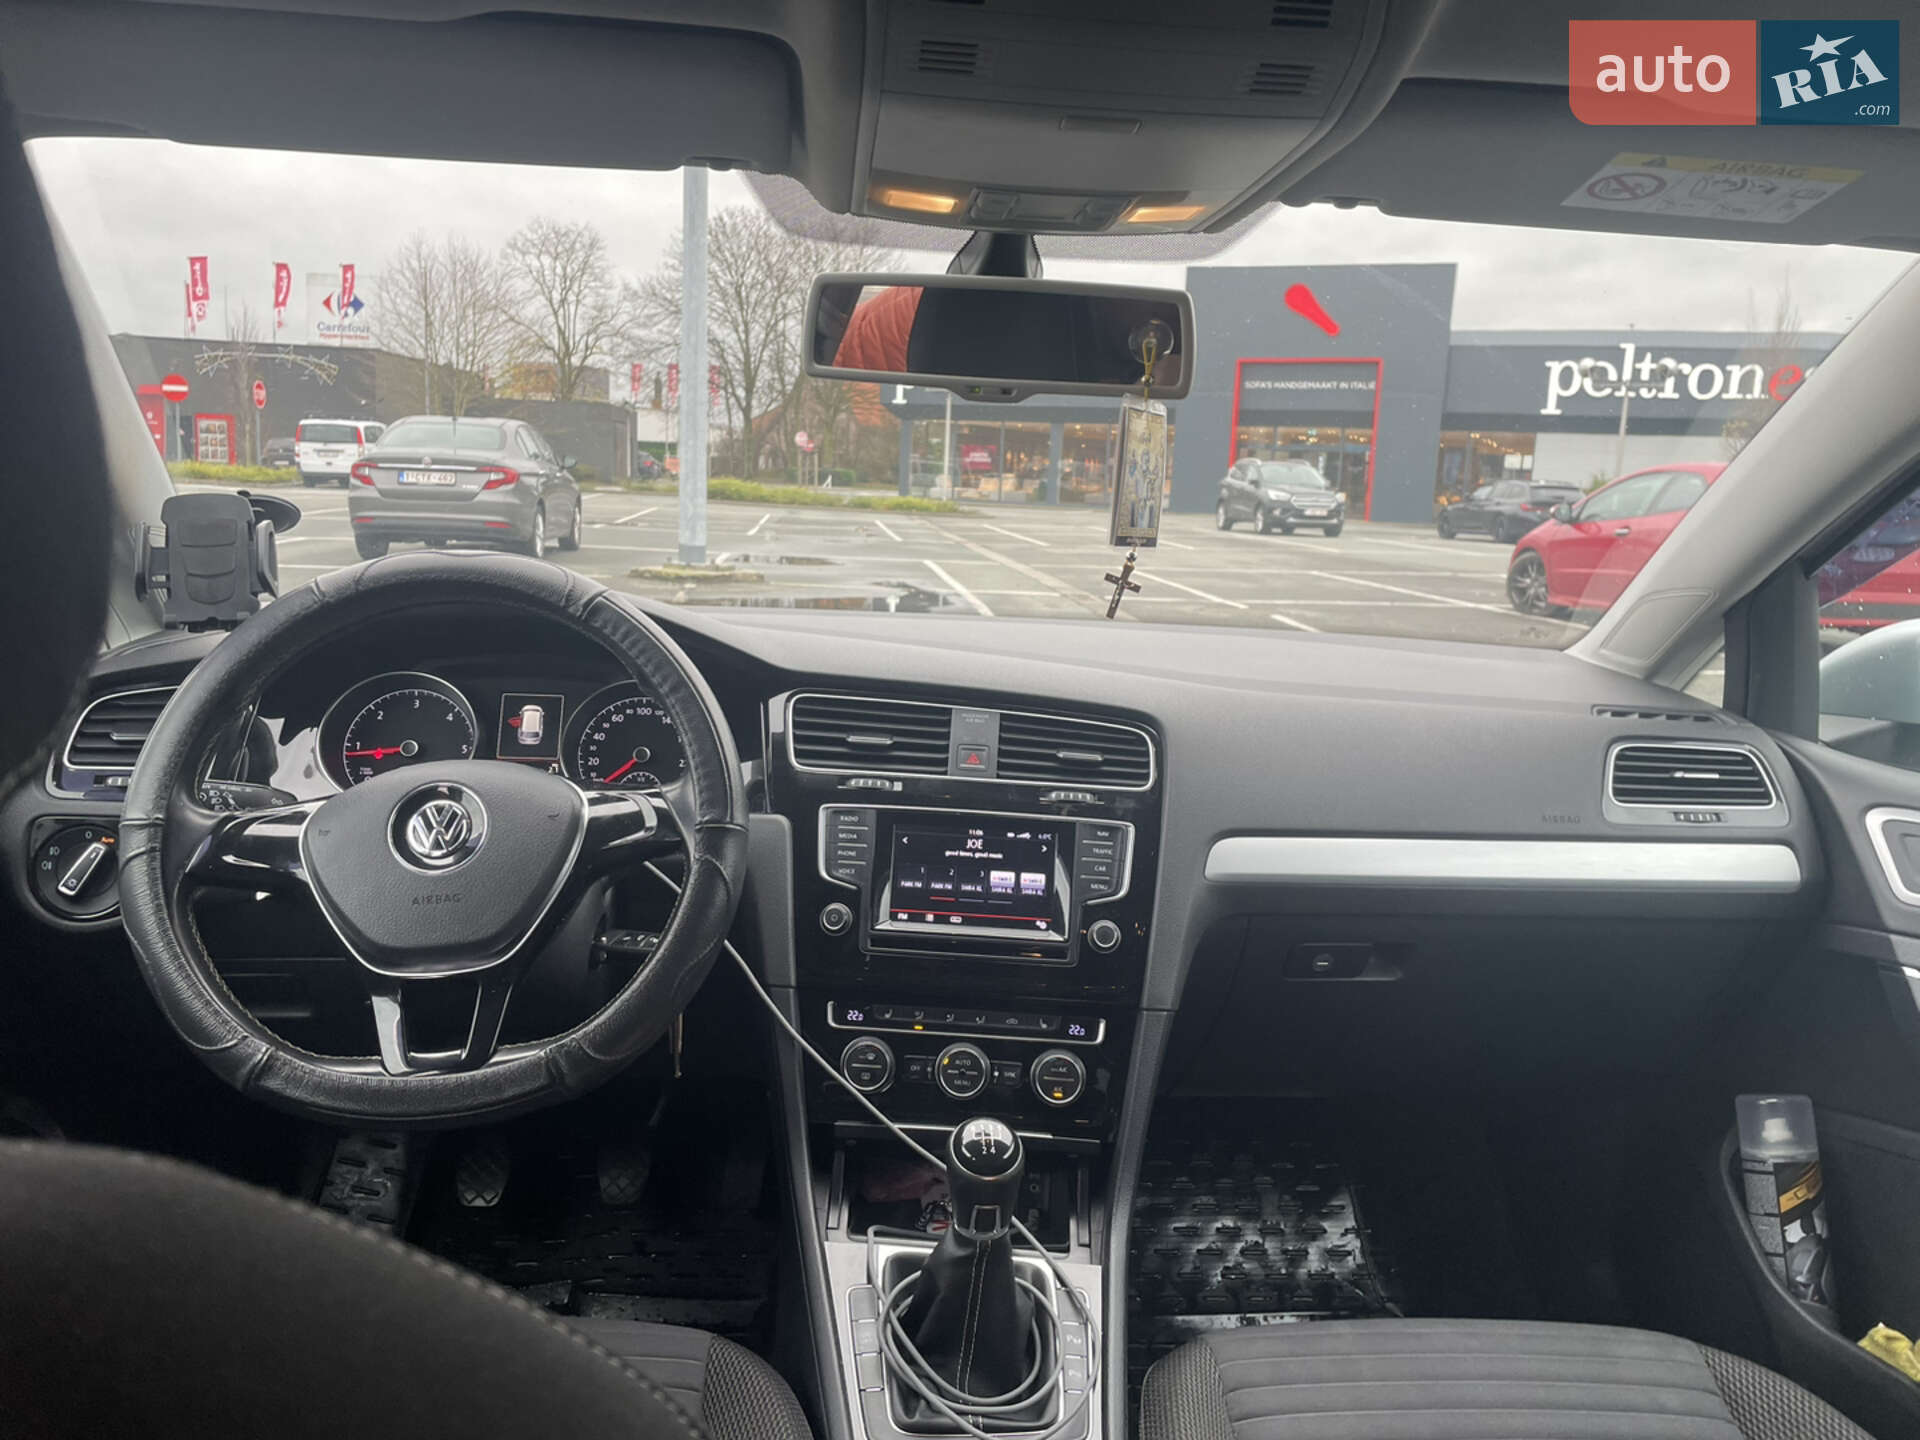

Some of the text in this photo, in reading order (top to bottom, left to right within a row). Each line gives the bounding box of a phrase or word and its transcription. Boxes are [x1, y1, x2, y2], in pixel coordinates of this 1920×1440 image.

[1710, 162, 1806, 178] AIRBAG
[317, 321, 370, 333] Carrefour
[1540, 343, 1815, 415] poltrone
[1273, 380, 1337, 390] HANDGEMAAKT
[1339, 380, 1349, 390] IN
[414, 700, 420, 709] 3
[377, 711, 384, 720] 2
[446, 713, 453, 721] 4
[611, 714, 624, 722] 60
[593, 733, 605, 741] 40
[462, 745, 468, 754] 5
[588, 757, 599, 766] 20
[966, 838, 983, 849] JOE
[1094, 864, 1106, 872] CAR
[411, 893, 464, 906] AIRBAG
[982, 1146, 996, 1155] 2 4
